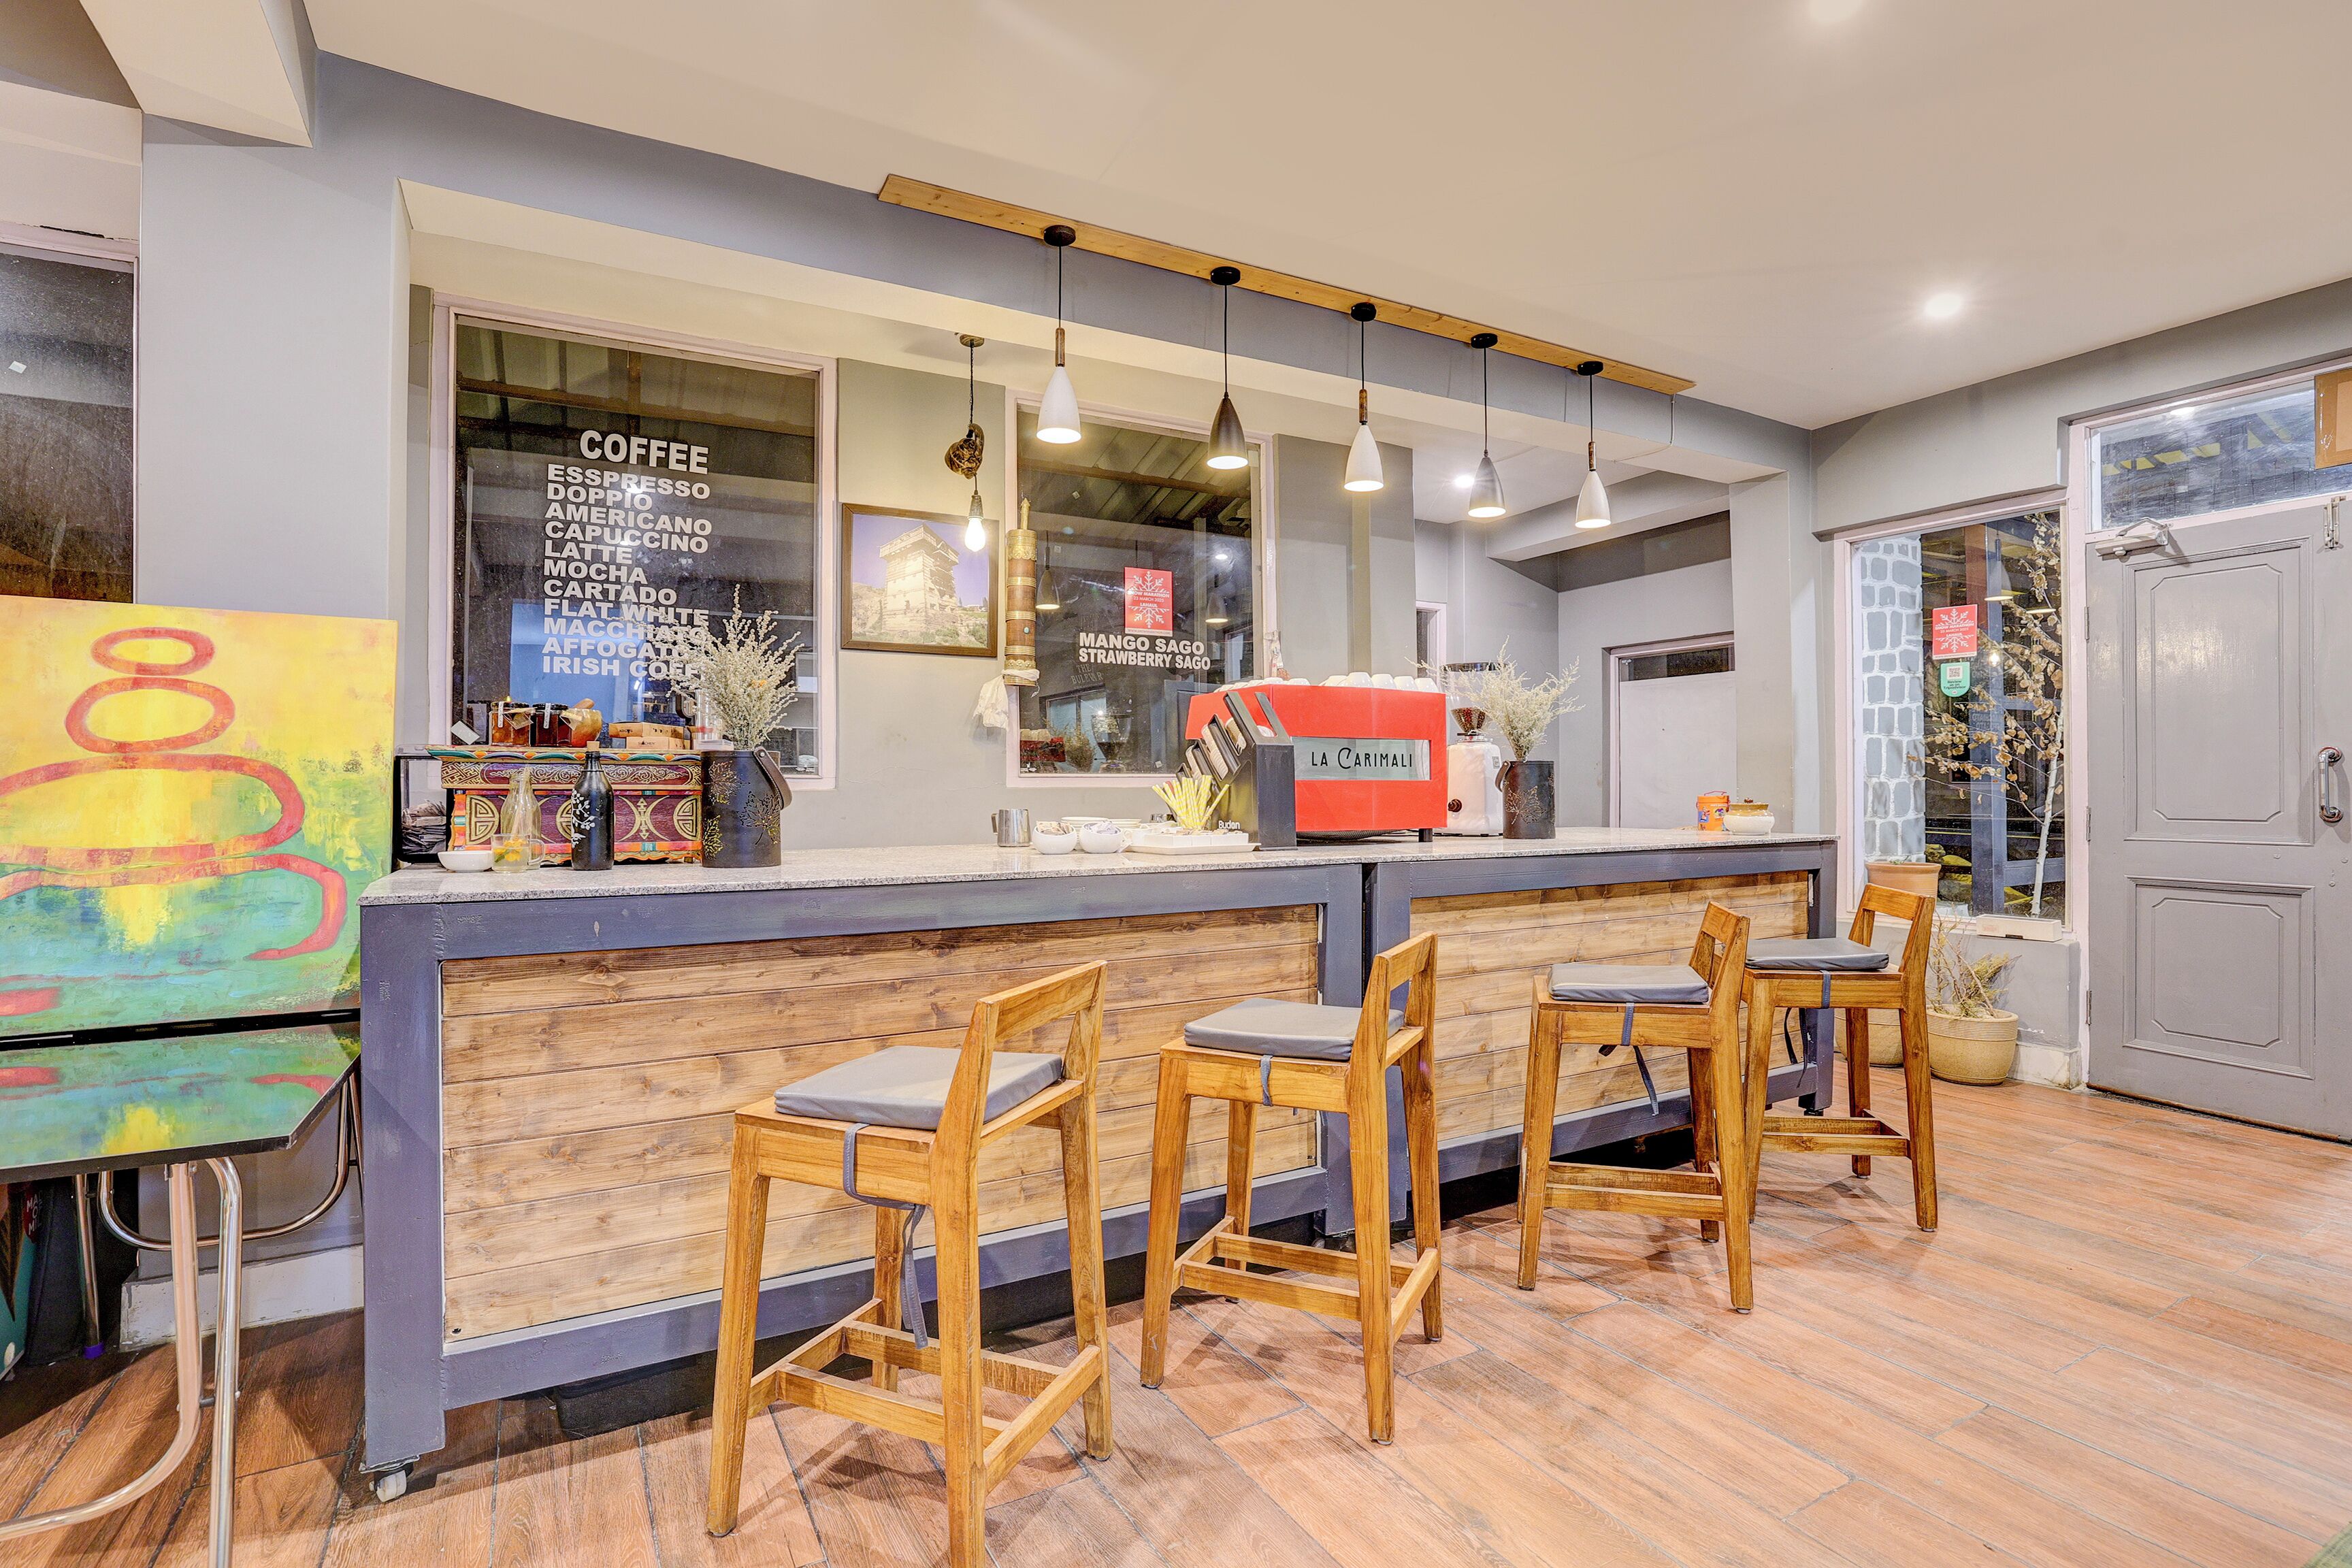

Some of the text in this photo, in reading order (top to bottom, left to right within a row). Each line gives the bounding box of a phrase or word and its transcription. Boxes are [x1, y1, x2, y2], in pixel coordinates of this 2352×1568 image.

[580, 430, 709, 474] COFFEE
[547, 463, 710, 500] ESSPRESSO
[546, 483, 653, 511] DOPPIO
[544, 502, 712, 536] AMERICANO
[544, 521, 708, 553] CAPUCCINO
[544, 540, 633, 564] LATTE
[544, 558, 648, 584] MOCHA
[544, 579, 677, 605] CARTADO
[544, 598, 709, 626] FLAT WHITE
[544, 618, 707, 644] MACCHIATO
[1079, 632, 1205, 655] MANGO SAGO
[543, 656, 620, 676] IRISH
[1079, 648, 1211, 670] STRAWBERRY SAGO
[1311, 752, 1328, 766] LA
